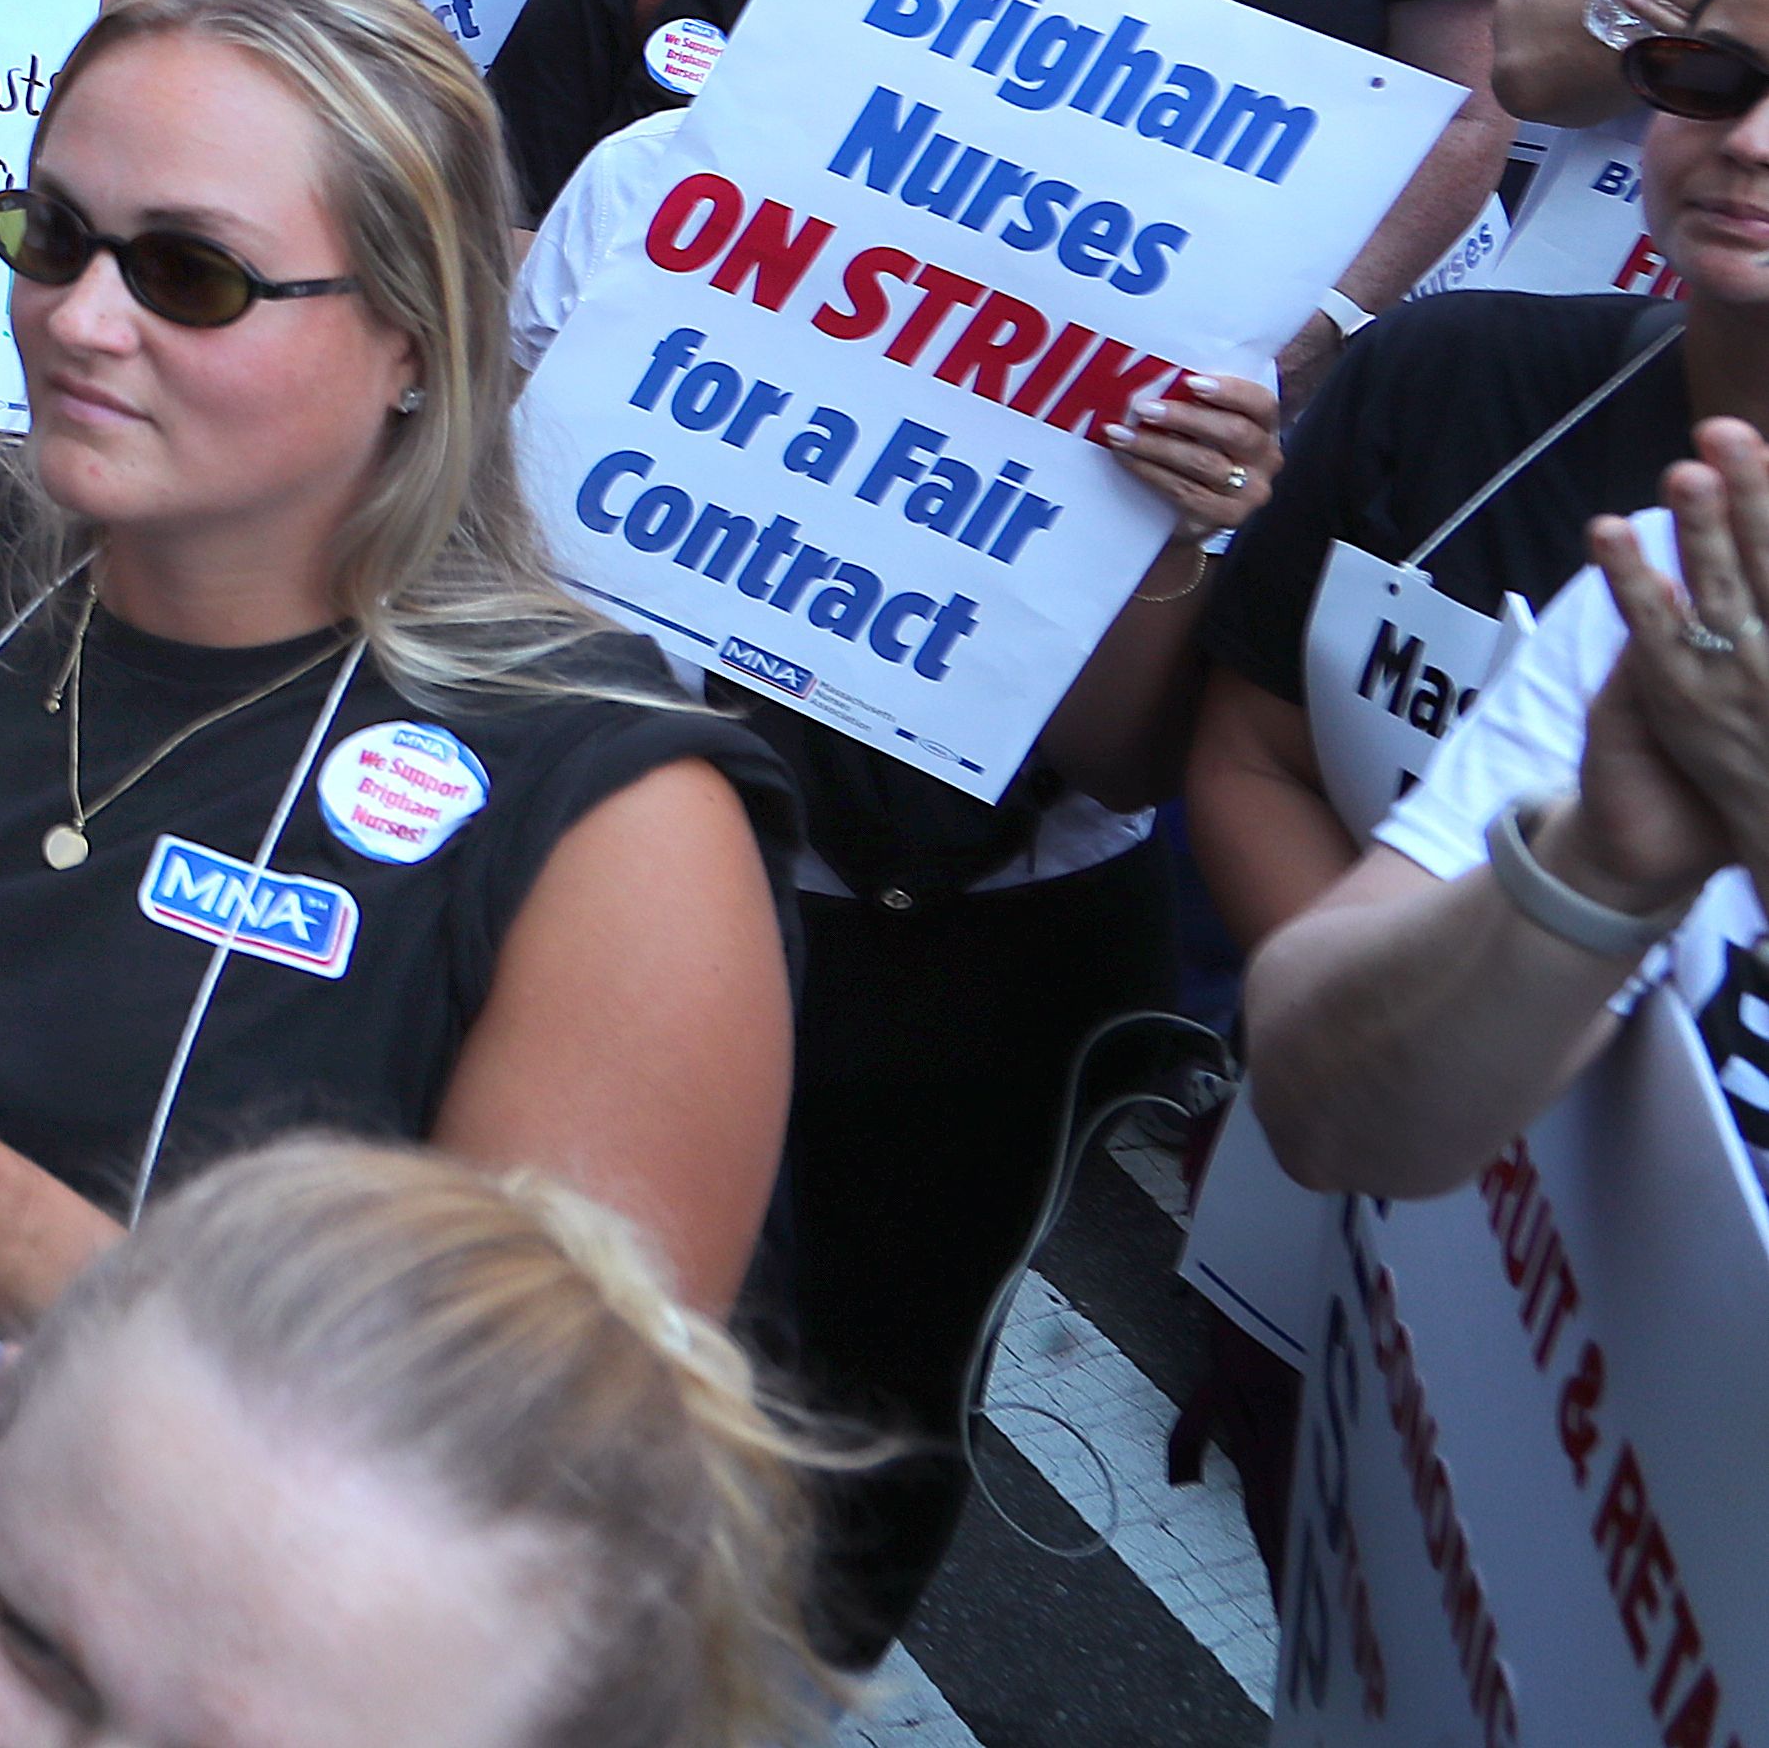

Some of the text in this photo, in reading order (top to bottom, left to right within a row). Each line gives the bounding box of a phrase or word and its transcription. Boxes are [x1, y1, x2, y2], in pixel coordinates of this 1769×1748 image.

[664, 33, 681, 46] We
[825, 84, 1190, 297] Nurses
[644, 171, 1214, 446] ON STRIK
[627, 327, 1067, 566] for a Fair
[574, 448, 982, 684] Contract
[725, 640, 804, 690] MNA
[394, 729, 448, 763] MNA
[357, 776, 442, 823] Brigham
[359, 748, 470, 801] We Support
[350, 803, 429, 845] Nurses!
[159, 856, 322, 944] MNA
